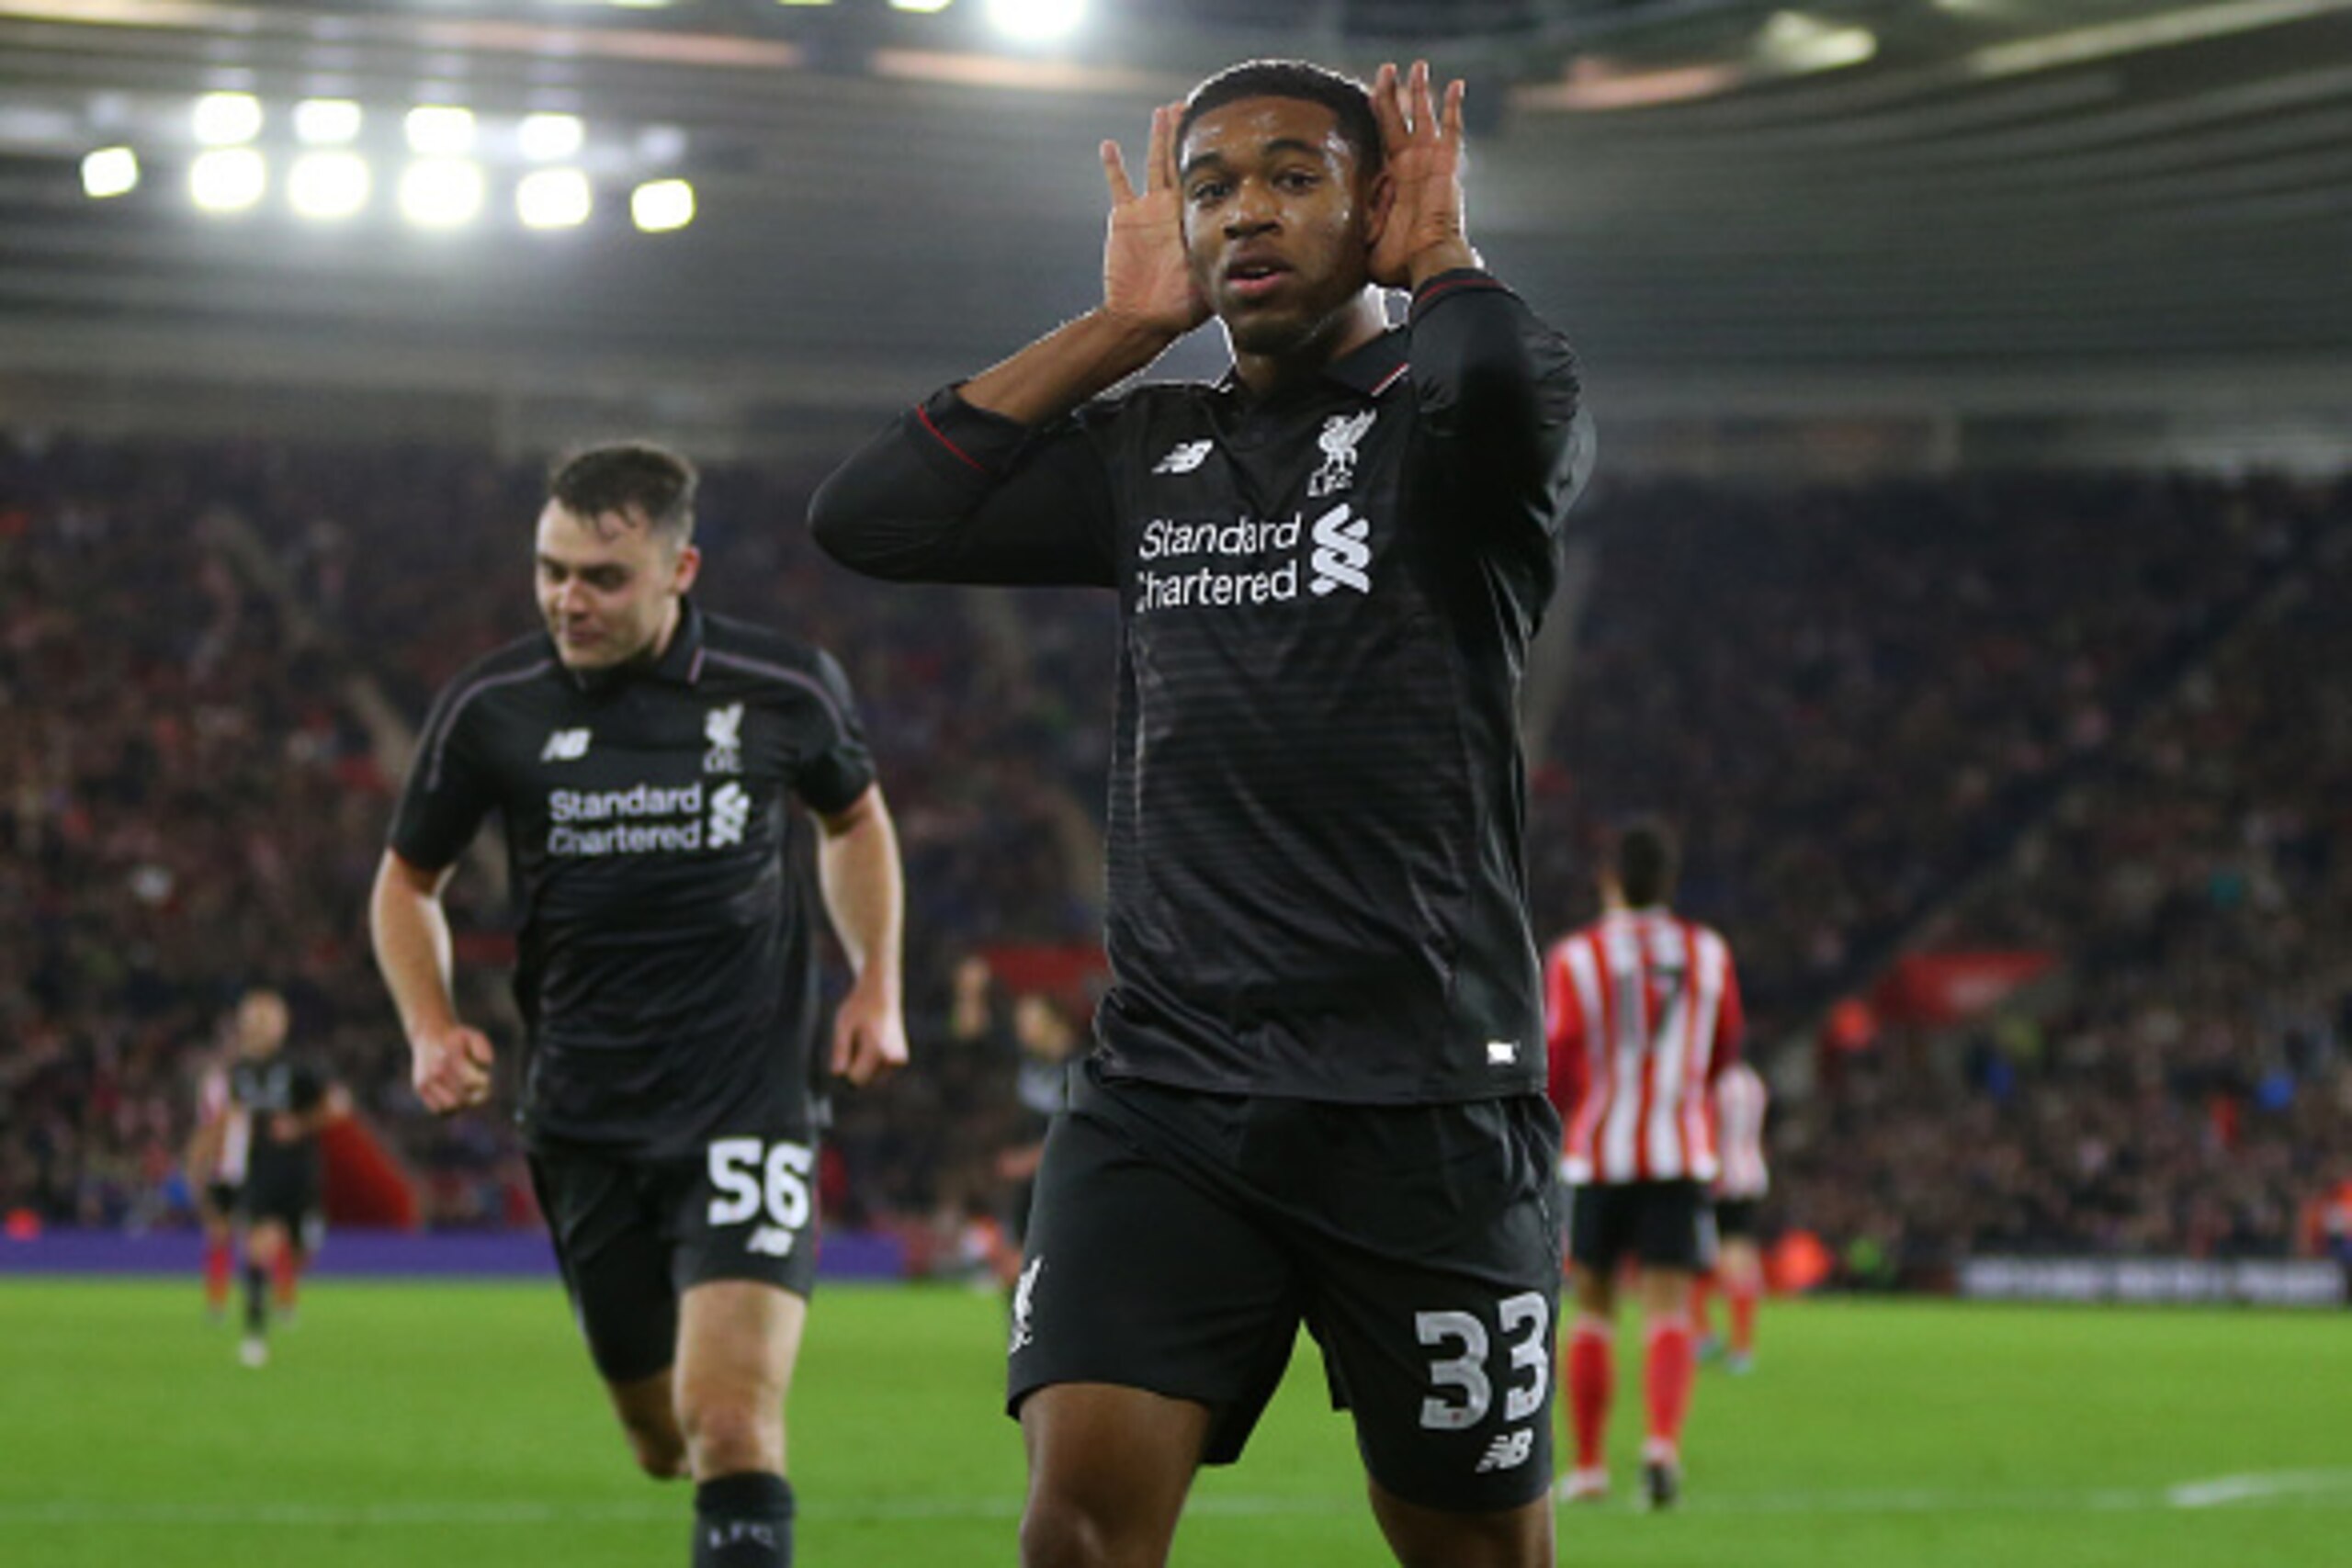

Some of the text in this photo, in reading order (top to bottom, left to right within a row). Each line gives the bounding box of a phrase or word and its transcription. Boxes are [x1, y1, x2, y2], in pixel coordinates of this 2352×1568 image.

[1138, 512, 1302, 560] Standard
[549, 783, 703, 821] Standard
[548, 819, 703, 853] Chartered
[707, 1137, 813, 1230] 56
[1415, 1292, 1549, 1429] 33
